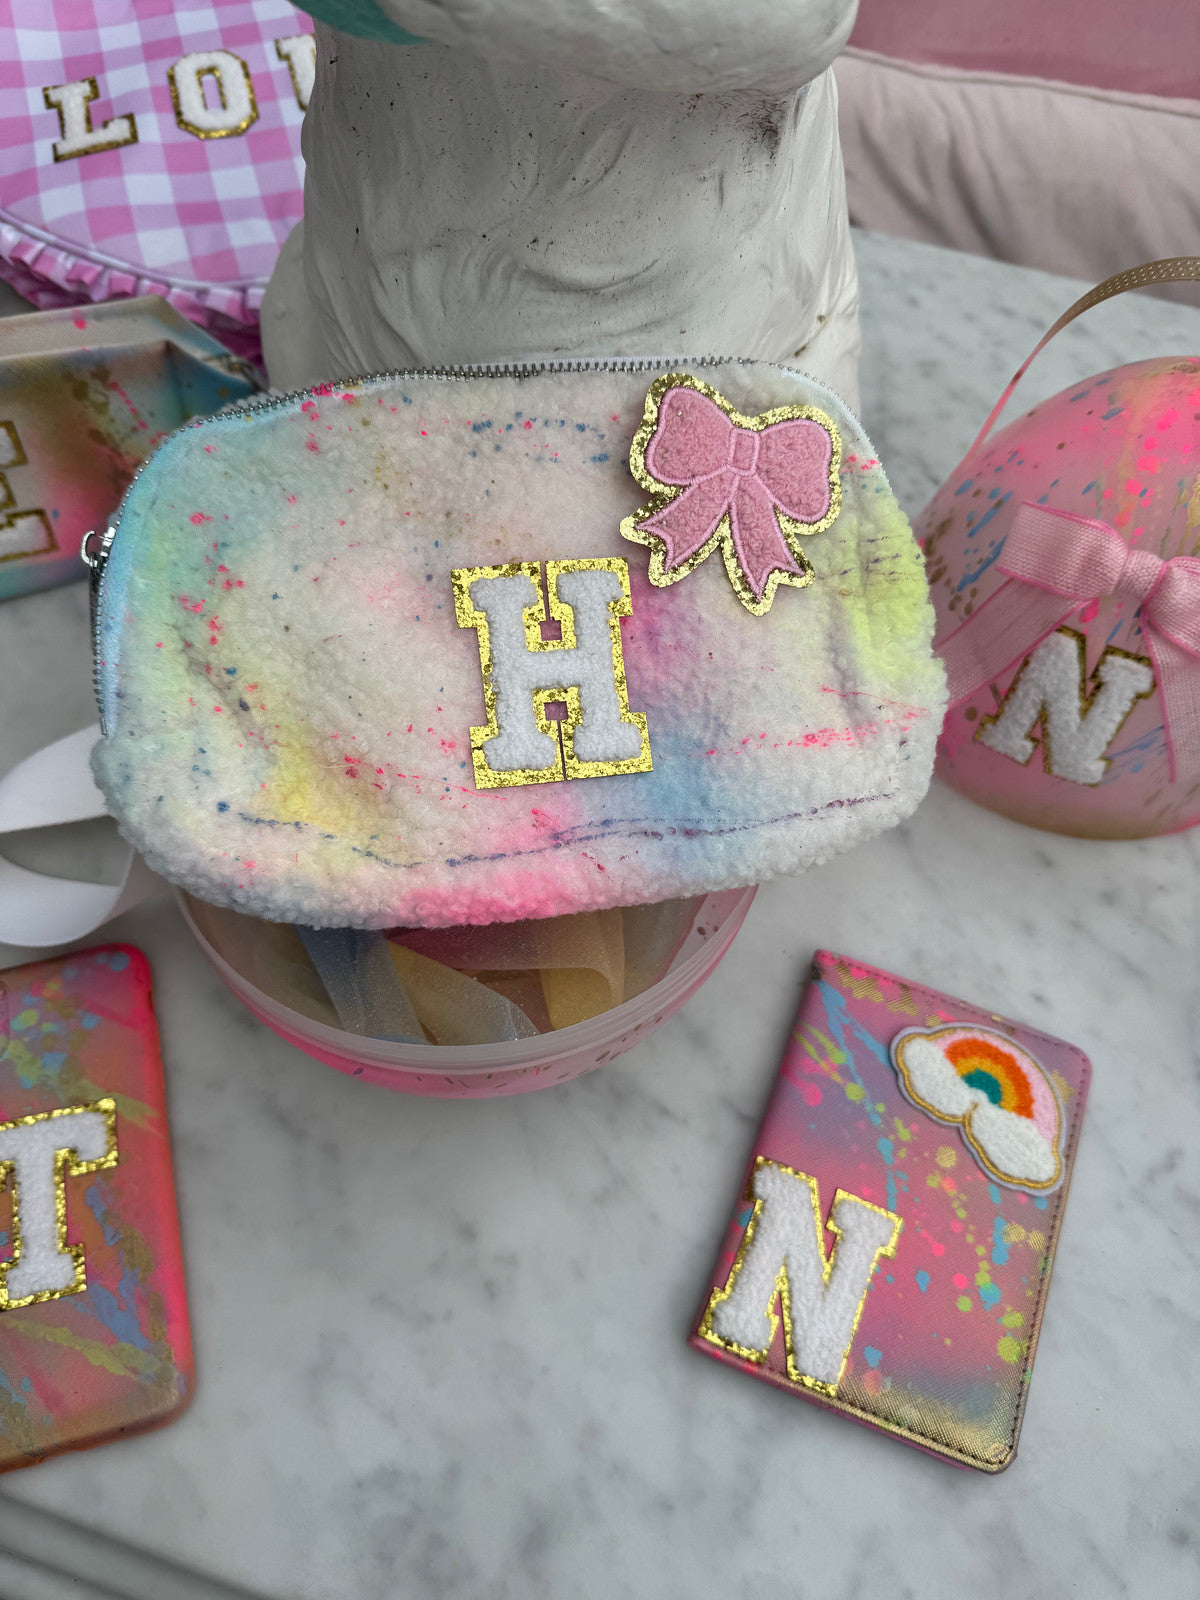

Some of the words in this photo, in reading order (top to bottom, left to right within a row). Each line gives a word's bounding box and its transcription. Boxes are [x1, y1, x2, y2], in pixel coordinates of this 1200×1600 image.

[450, 556, 653, 789] H
[973, 625, 1156, 787] N
[698, 1155, 903, 1397] N
